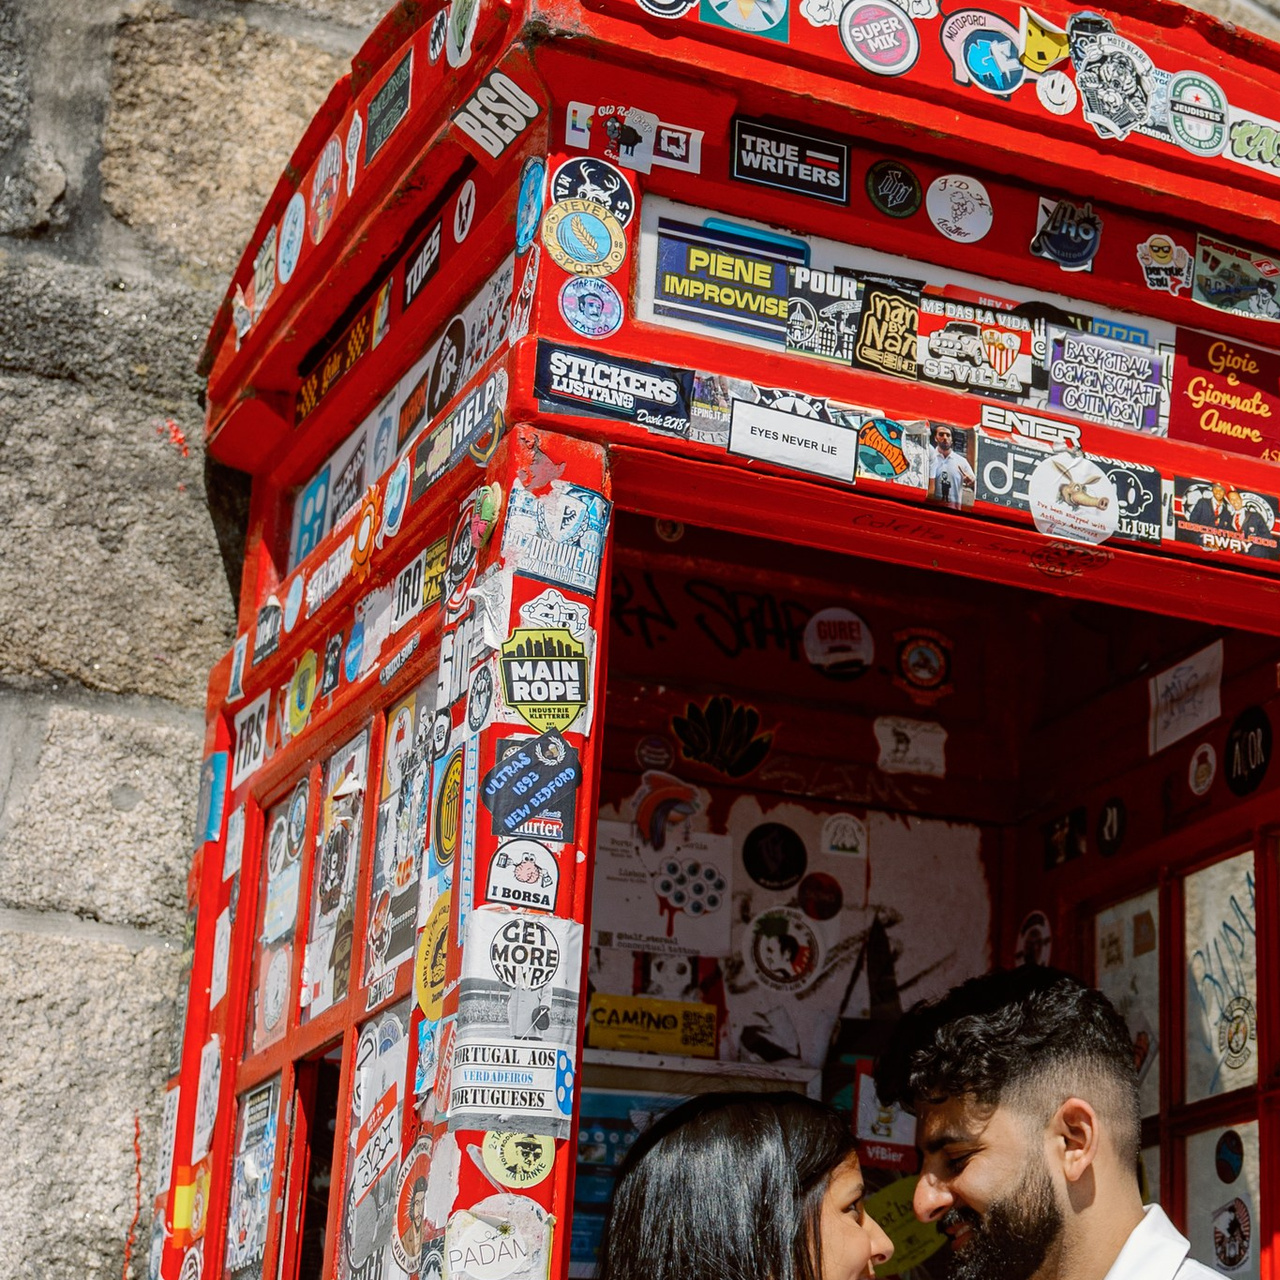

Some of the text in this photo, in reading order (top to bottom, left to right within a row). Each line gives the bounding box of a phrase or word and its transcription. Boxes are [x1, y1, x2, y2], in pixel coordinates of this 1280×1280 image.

[850, 16, 903, 42] SUPER
[866, 28, 902, 53] MIK
[945, 15, 988, 42] MOTOPORCI
[454, 73, 540, 159] BESO
[1173, 103, 1222, 122] JEUDISTES
[741, 133, 800, 162] TRUE
[741, 150, 840, 188] WRITERS
[557, 200, 616, 222] VEVEY
[405, 225, 441, 295] TOES
[555, 250, 613, 277] SPORTS
[689, 248, 772, 289] PIENE
[572, 319, 609, 333] TATTOO
[920, 297, 1031, 331] ME DAS LA VIDA
[889, 321, 907, 335] BY
[1208, 341, 1260, 375] Gioie
[550, 351, 678, 406] STICKERS
[923, 359, 1023, 393] SEVILLA
[1227, 370, 1240, 387] e
[1187, 376, 1272, 418] Giornate
[981, 404, 1081, 449] ENTER
[1200, 409, 1263, 443] Amare
[750, 425, 838, 456] EYES NEVER LIE
[1202, 532, 1254, 553] AWAY
[510, 661, 580, 681] MAIN
[513, 681, 581, 702] ROPE
[485, 751, 532, 797] ULTRAS
[512, 771, 541, 797] 1893
[503, 767, 577, 830] NEW BEDFORD
[491, 885, 551, 907] I BORSA
[502, 922, 546, 947] GET
[491, 943, 558, 969] MORE
[592, 1007, 679, 1031] CAMINO
[453, 1046, 556, 1067] PORTUGAL AOS
[463, 1070, 534, 1084] VERDADEIROS
[451, 1089, 546, 1108] PORTUGUESES
